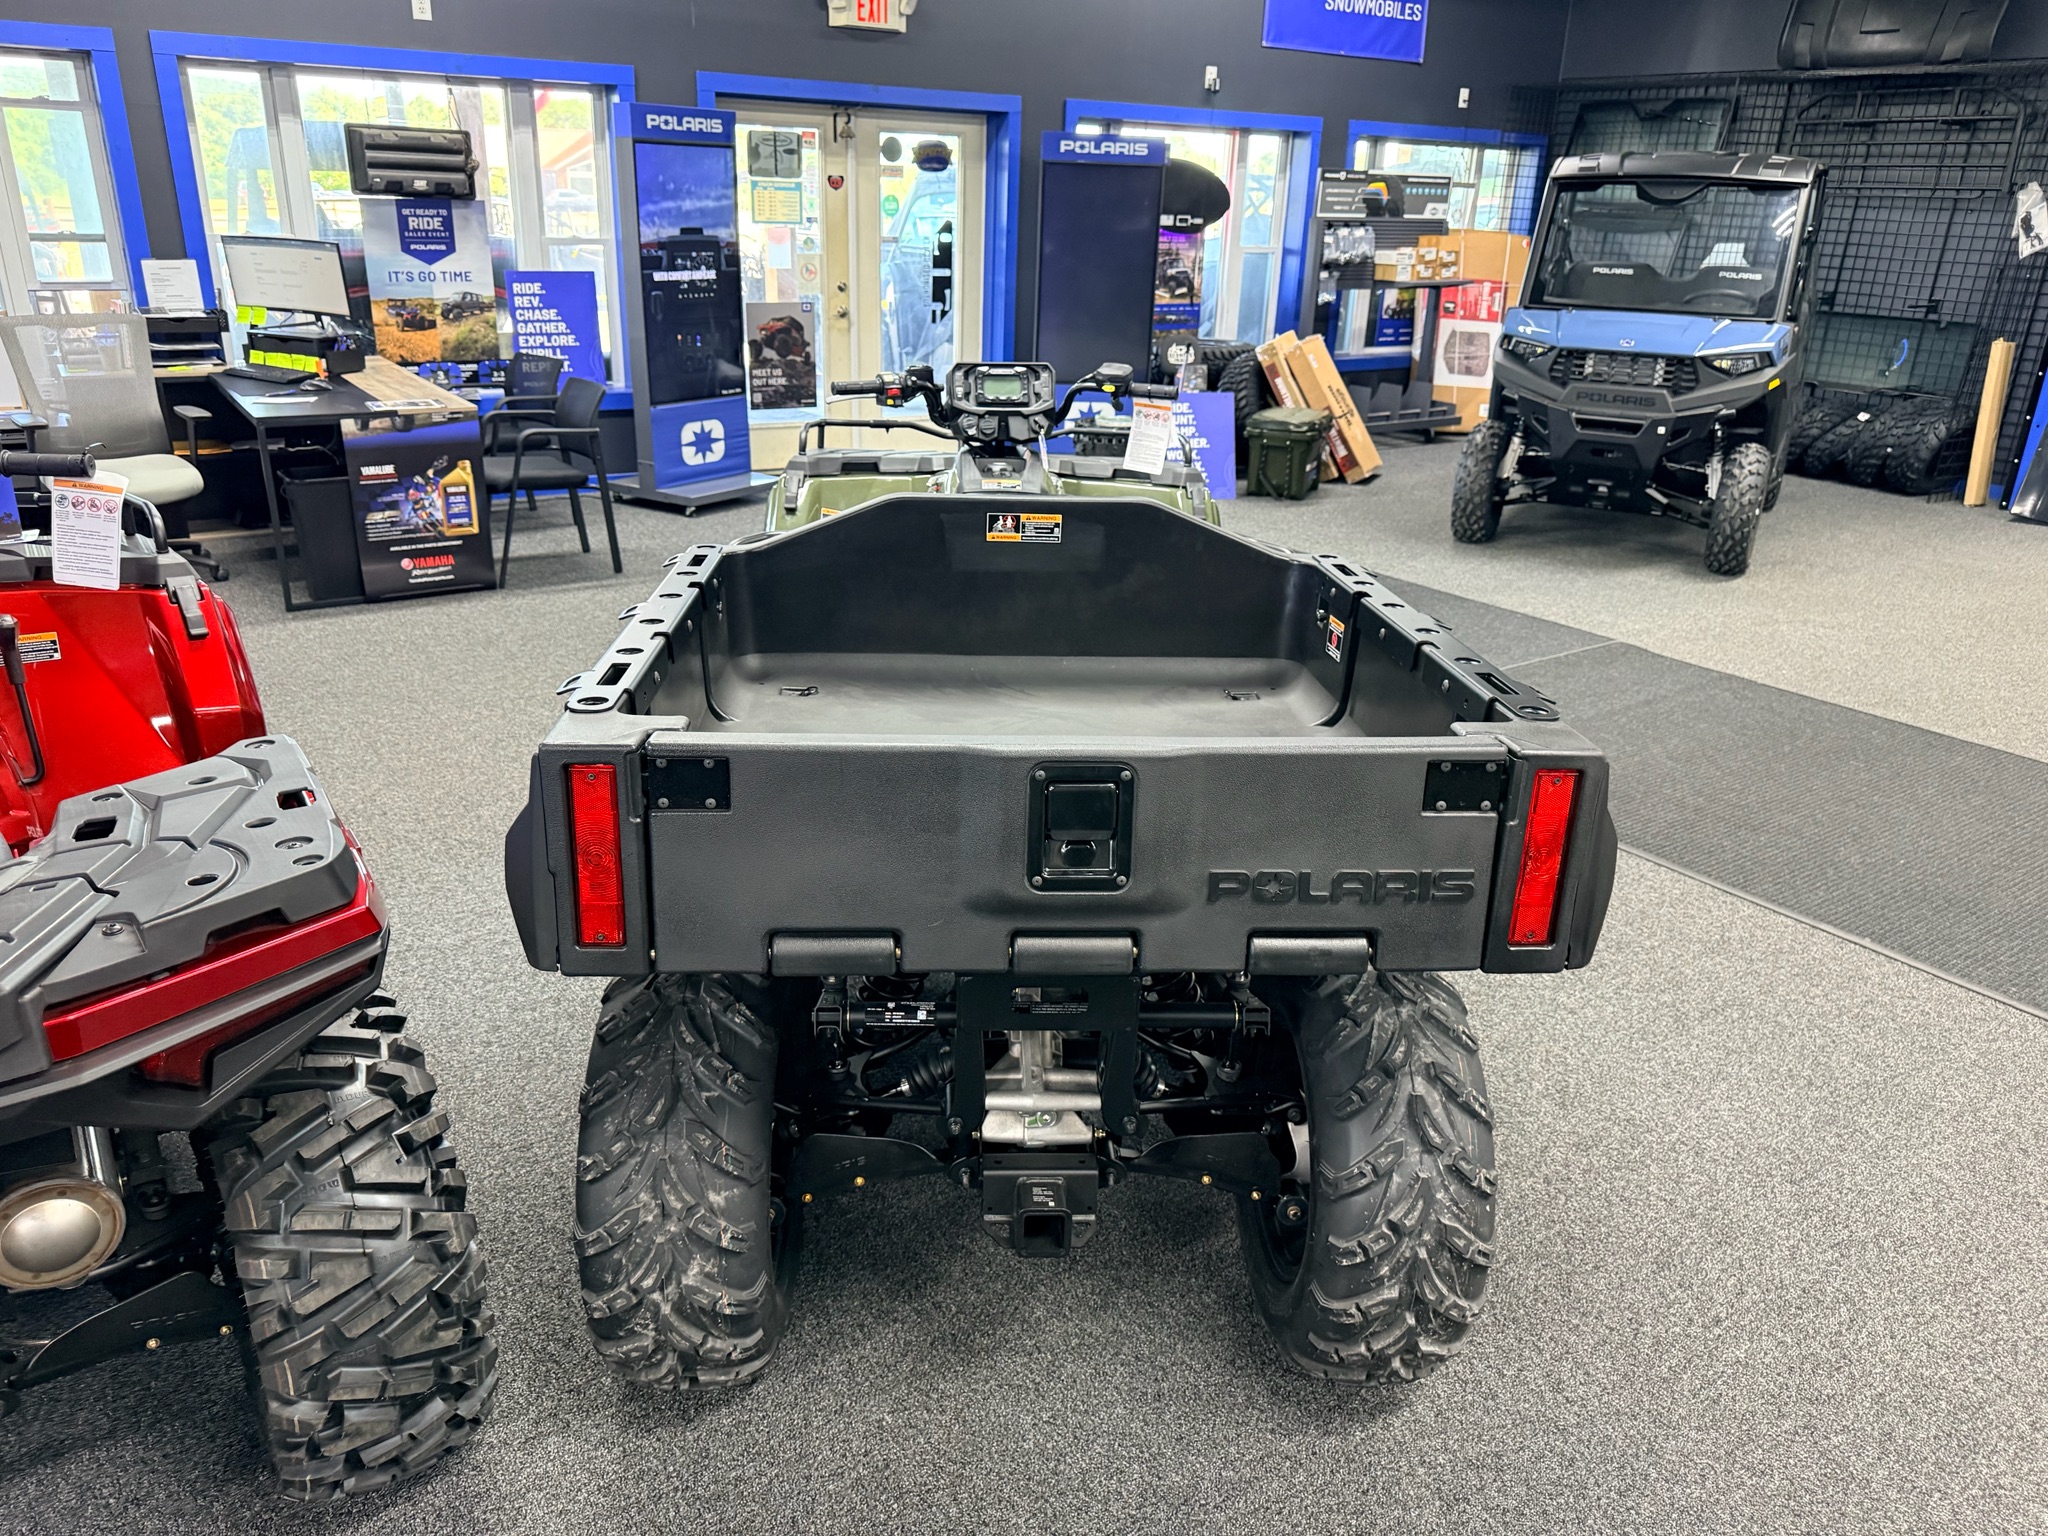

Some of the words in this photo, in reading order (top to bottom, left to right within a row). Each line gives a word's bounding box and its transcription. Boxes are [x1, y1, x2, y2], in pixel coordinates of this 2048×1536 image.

[1325, 0, 1422, 21] SNOWMOBILES
[646, 114, 723, 133] POLARIS
[1060, 140, 1148, 156] POLARIS
[415, 208, 437, 216] READY
[408, 217, 444, 231] RIDE
[388, 271, 414, 283] IT'S
[418, 271, 436, 282] GO
[440, 271, 473, 282] TIME
[1592, 267, 1634, 275] POLARIS
[1719, 271, 1763, 280] POLARIS
[512, 282, 546, 294] RIDE.
[513, 295, 544, 308] REV.
[515, 309, 562, 321] CHASE.
[517, 322, 571, 334] GATHER.
[518, 335, 580, 347] EXPLORE.
[752, 368, 771, 377] MEET
[1576, 391, 1656, 408] POLARIS
[1172, 402, 1193, 413] IDE.
[78, 483, 104, 491] WARNING
[413, 554, 455, 569] YAMAHA
[1206, 869, 1475, 904] POLARIS
